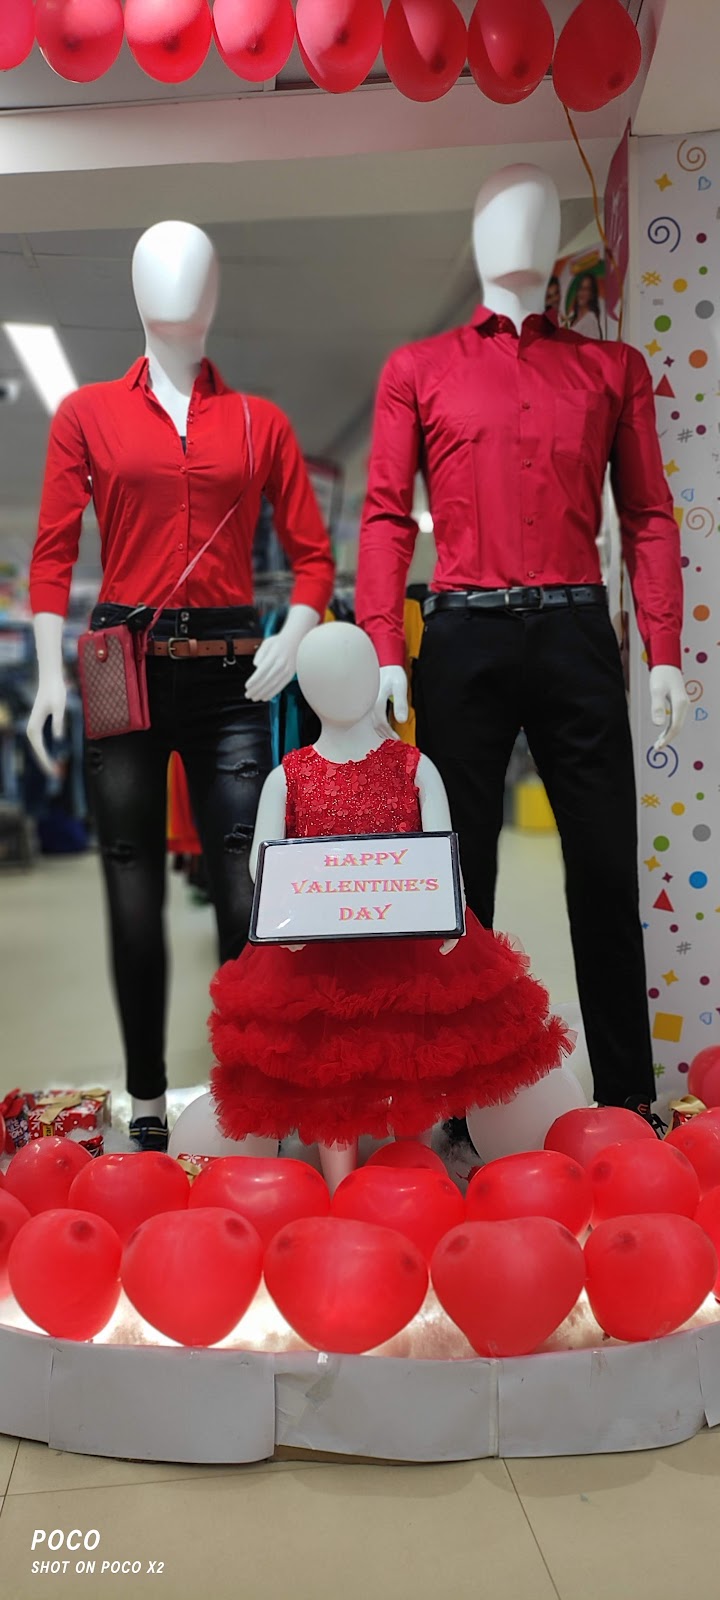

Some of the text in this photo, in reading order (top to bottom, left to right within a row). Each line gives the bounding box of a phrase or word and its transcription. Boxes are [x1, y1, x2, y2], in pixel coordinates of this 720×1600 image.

[323, 848, 408, 867] HAPPY
[291, 878, 439, 895] VALENTINE'S
[338, 903, 392, 921] DAY
